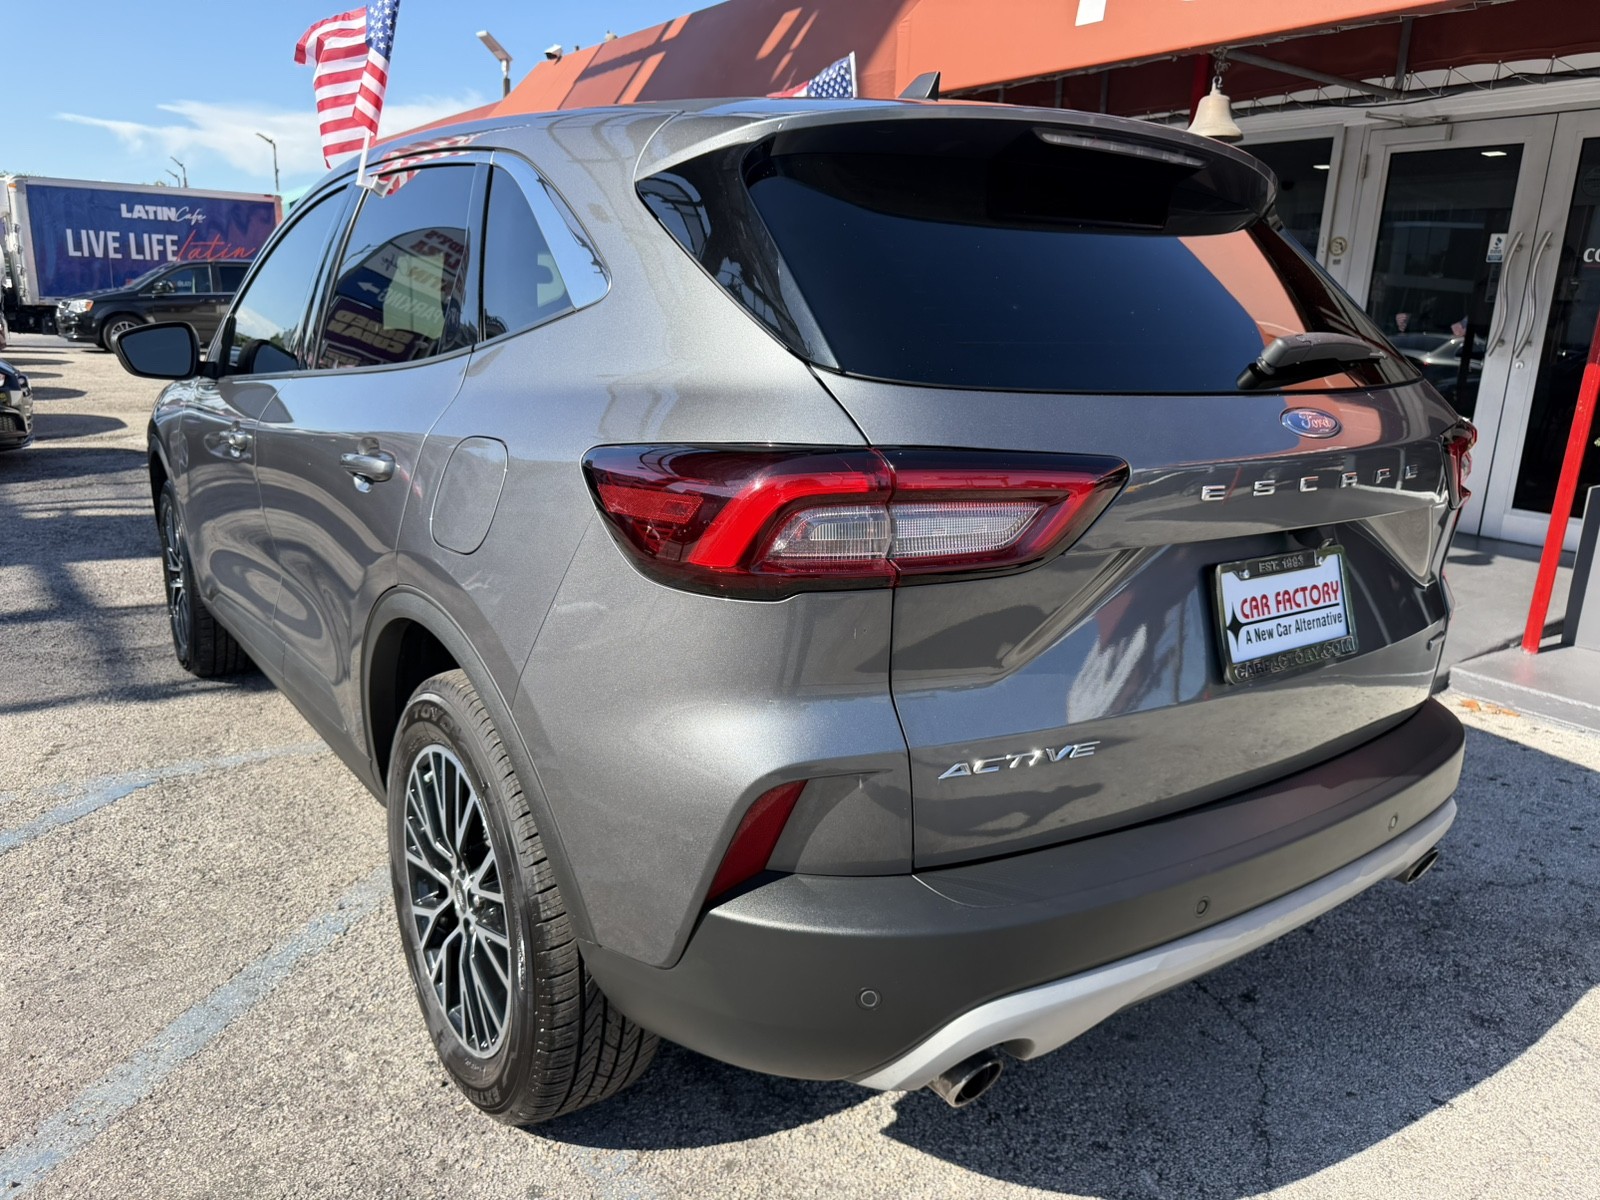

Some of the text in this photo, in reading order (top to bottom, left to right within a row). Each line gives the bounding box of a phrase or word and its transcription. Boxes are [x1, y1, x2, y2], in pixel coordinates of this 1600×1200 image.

[120, 203, 177, 221] LATIN
[65, 228, 123, 259] LIVE
[128, 232, 179, 262] LIFE
[1299, 411, 1332, 431] Ford
[1200, 464, 1419, 502] ESCAPE
[1240, 580, 1340, 620] CAR FACTORY
[1245, 611, 1343, 645] A New Car Alternative
[937, 740, 1101, 780] ACTIVE
